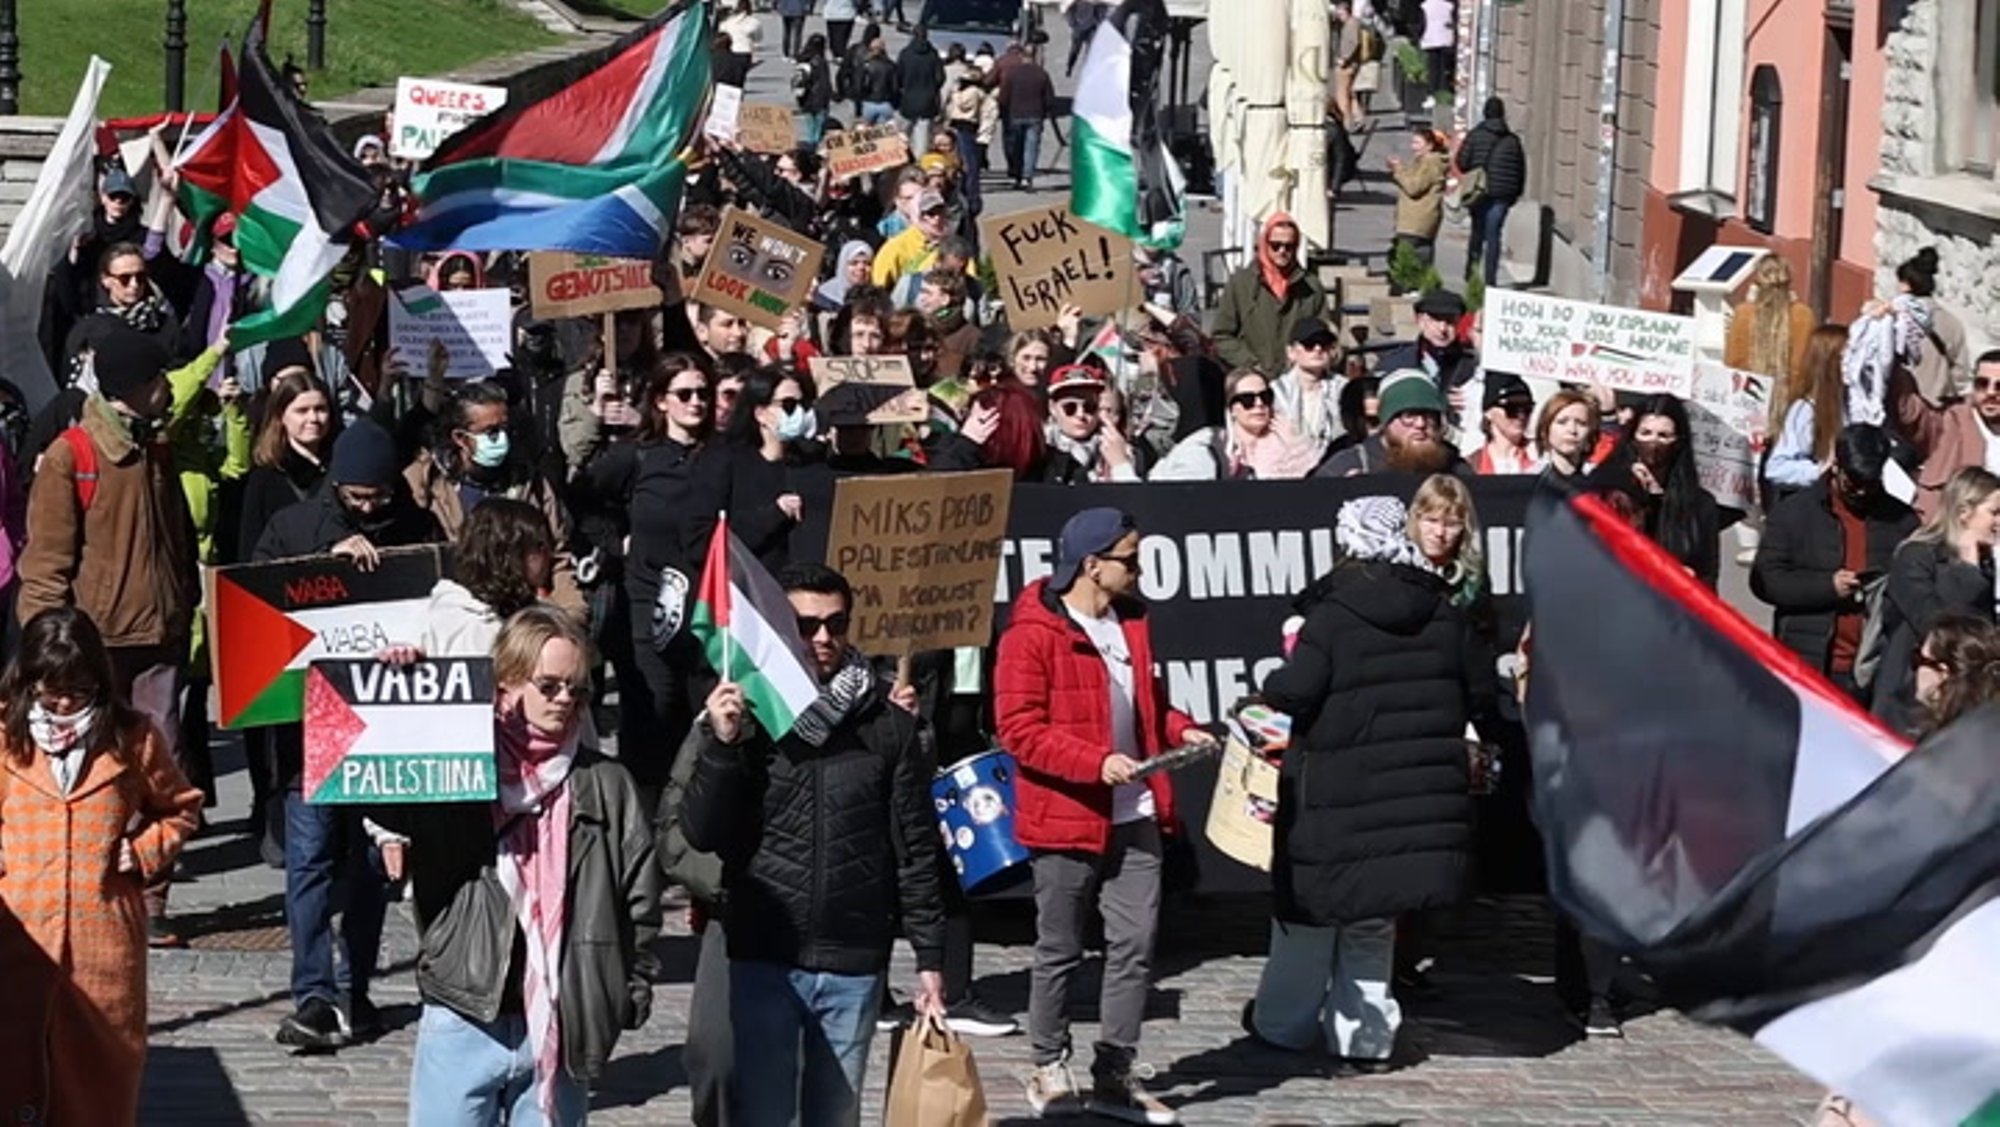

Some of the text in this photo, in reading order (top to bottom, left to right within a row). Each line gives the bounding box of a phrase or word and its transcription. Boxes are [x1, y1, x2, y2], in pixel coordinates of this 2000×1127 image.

[409, 85, 486, 110] QUEERS
[731, 220, 757, 244] WE
[706, 270, 750, 302] LOOK
[1501, 300, 1545, 321] HOW
[1551, 305, 1576, 322] DO
[1585, 310, 1616, 328] YOU
[1498, 318, 1525, 334] TO
[1628, 333, 1667, 353] WHY
[826, 359, 880, 382] STOP
[852, 498, 933, 535] MIKS
[284, 574, 349, 603] VABA
[898, 579, 986, 609] KODUST
[320, 621, 389, 654] VABA
[350, 661, 474, 702] VABA
[341, 759, 488, 796] PALESTIINA
